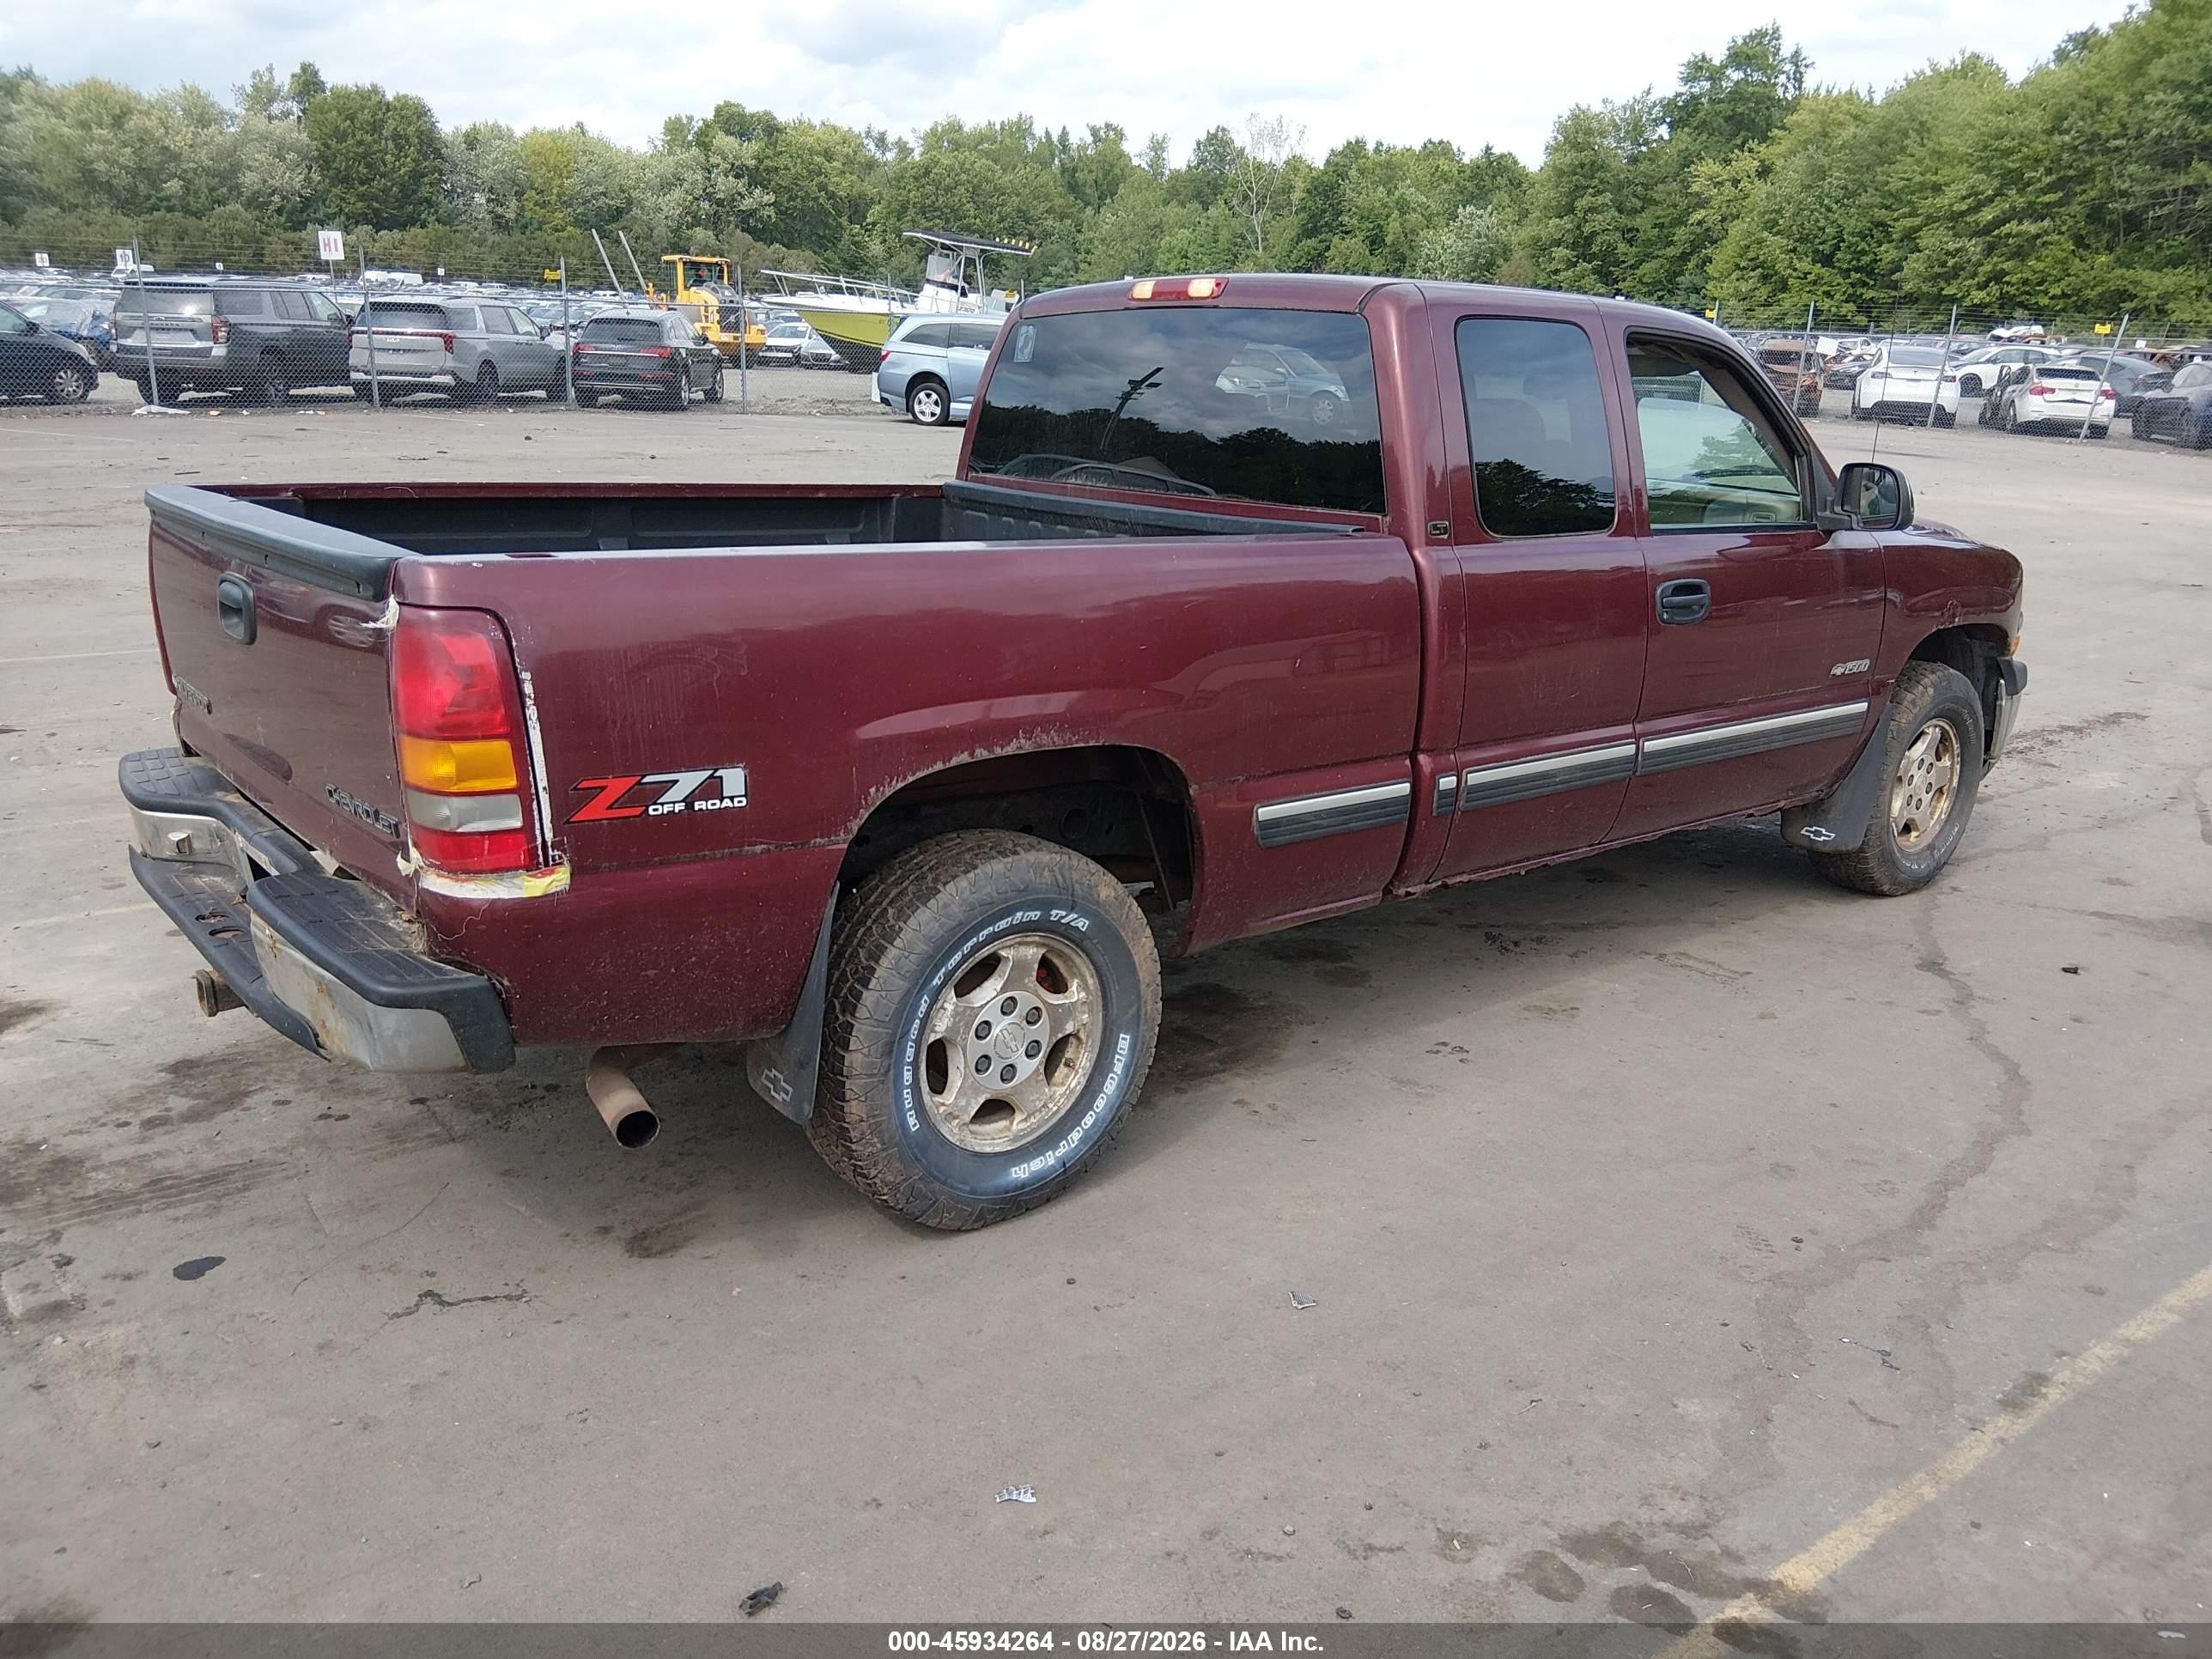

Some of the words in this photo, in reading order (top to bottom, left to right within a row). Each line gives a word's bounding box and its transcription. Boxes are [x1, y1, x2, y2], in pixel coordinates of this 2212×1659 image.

[1431, 524, 1447, 534] LT
[326, 782, 401, 839] CHEVROLET
[563, 765, 748, 824] Z71
[647, 801, 686, 817] OFF
[694, 797, 747, 811] ROAD
[933, 910, 1042, 988] Terrain
[1049, 908, 1090, 933] T/A
[1011, 1033, 1131, 1179] BFGoodrich
